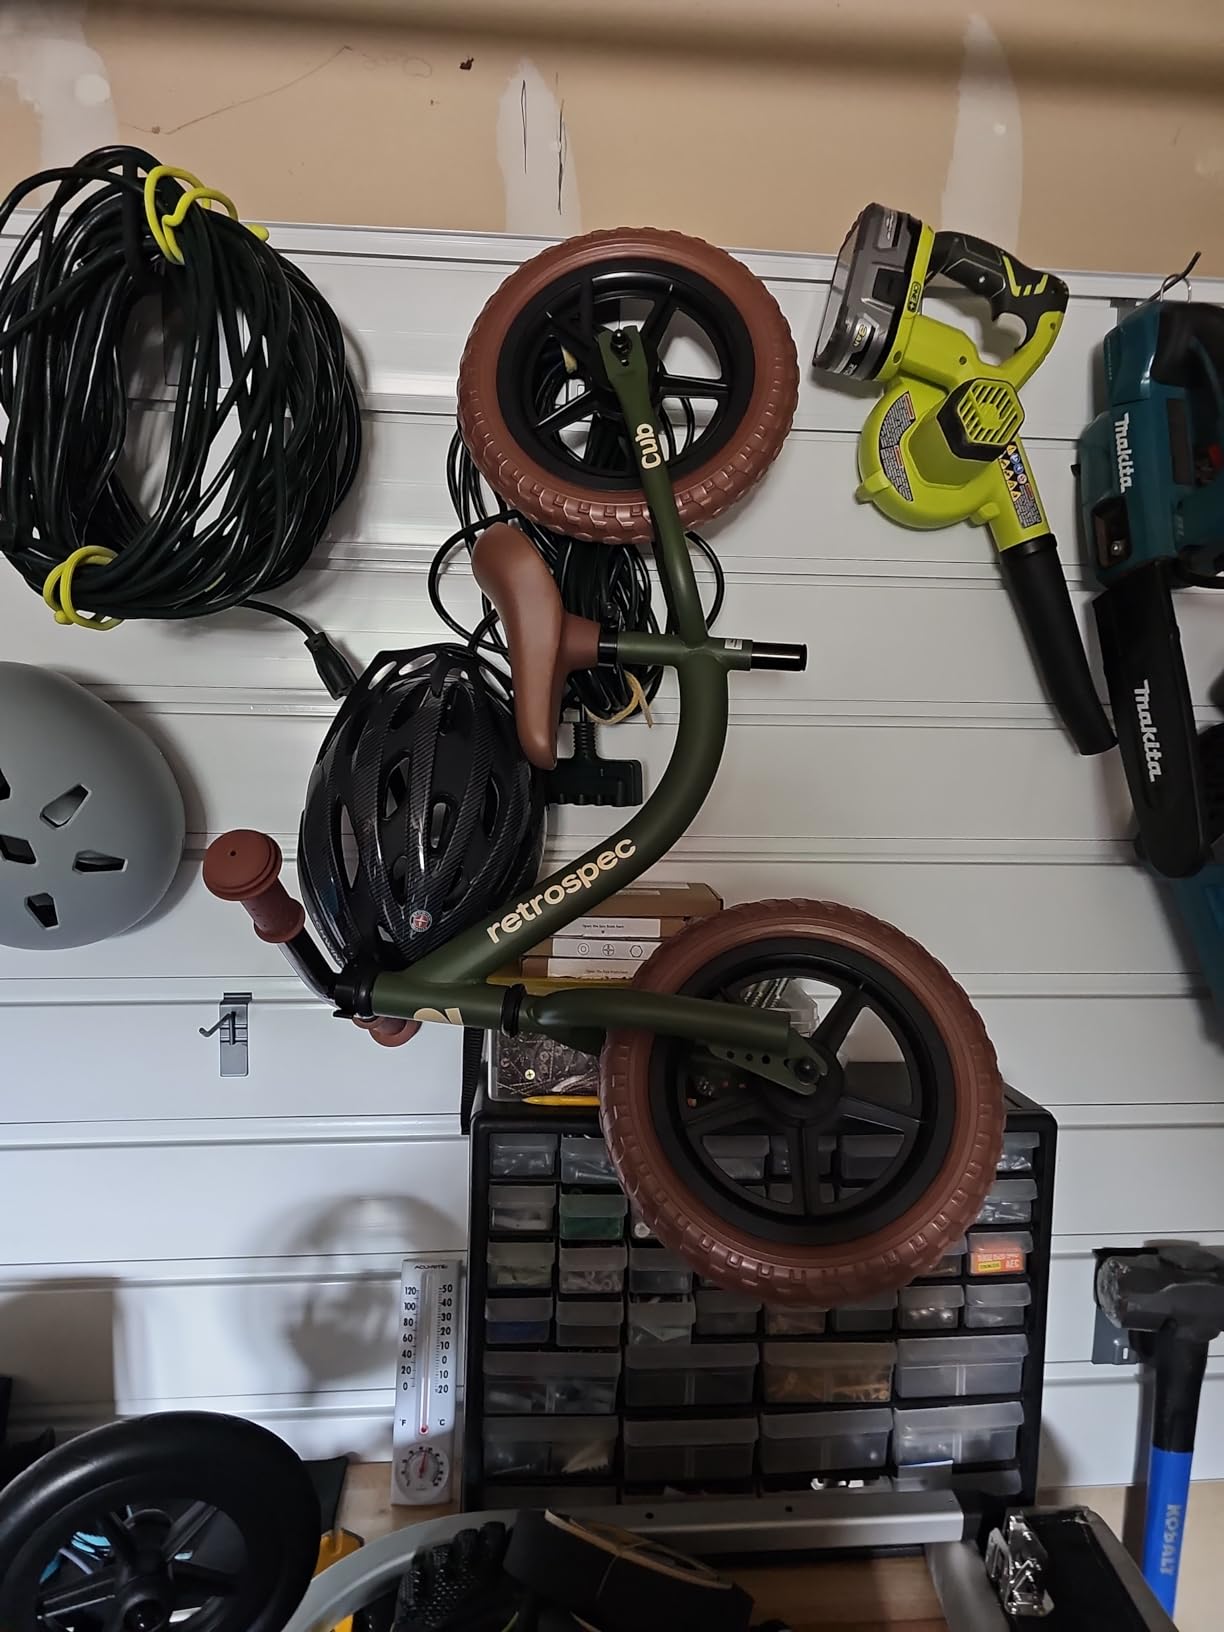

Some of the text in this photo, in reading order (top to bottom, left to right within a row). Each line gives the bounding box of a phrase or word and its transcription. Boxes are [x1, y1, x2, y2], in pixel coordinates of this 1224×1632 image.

[634, 423, 661, 470] cub
[486, 838, 636, 944] retrospec
[404, 1286, 417, 1296] 120
[442, 1283, 453, 1293] 50
[404, 1302, 416, 1311] 100
[441, 1298, 452, 1307] 40
[441, 1312, 452, 1321] 30
[403, 1318, 414, 1327] 80
[440, 1326, 451, 1335] 20
[402, 1333, 413, 1342] 60
[440, 1341, 450, 1350] 10
[402, 1350, 412, 1358] 40
[441, 1355, 448, 1364] 0
[401, 1366, 412, 1374] 20
[440, 1370, 449, 1379] 10
[402, 1382, 408, 1391] 0
[1160, 1503, 1182, 1576] KOBALT
